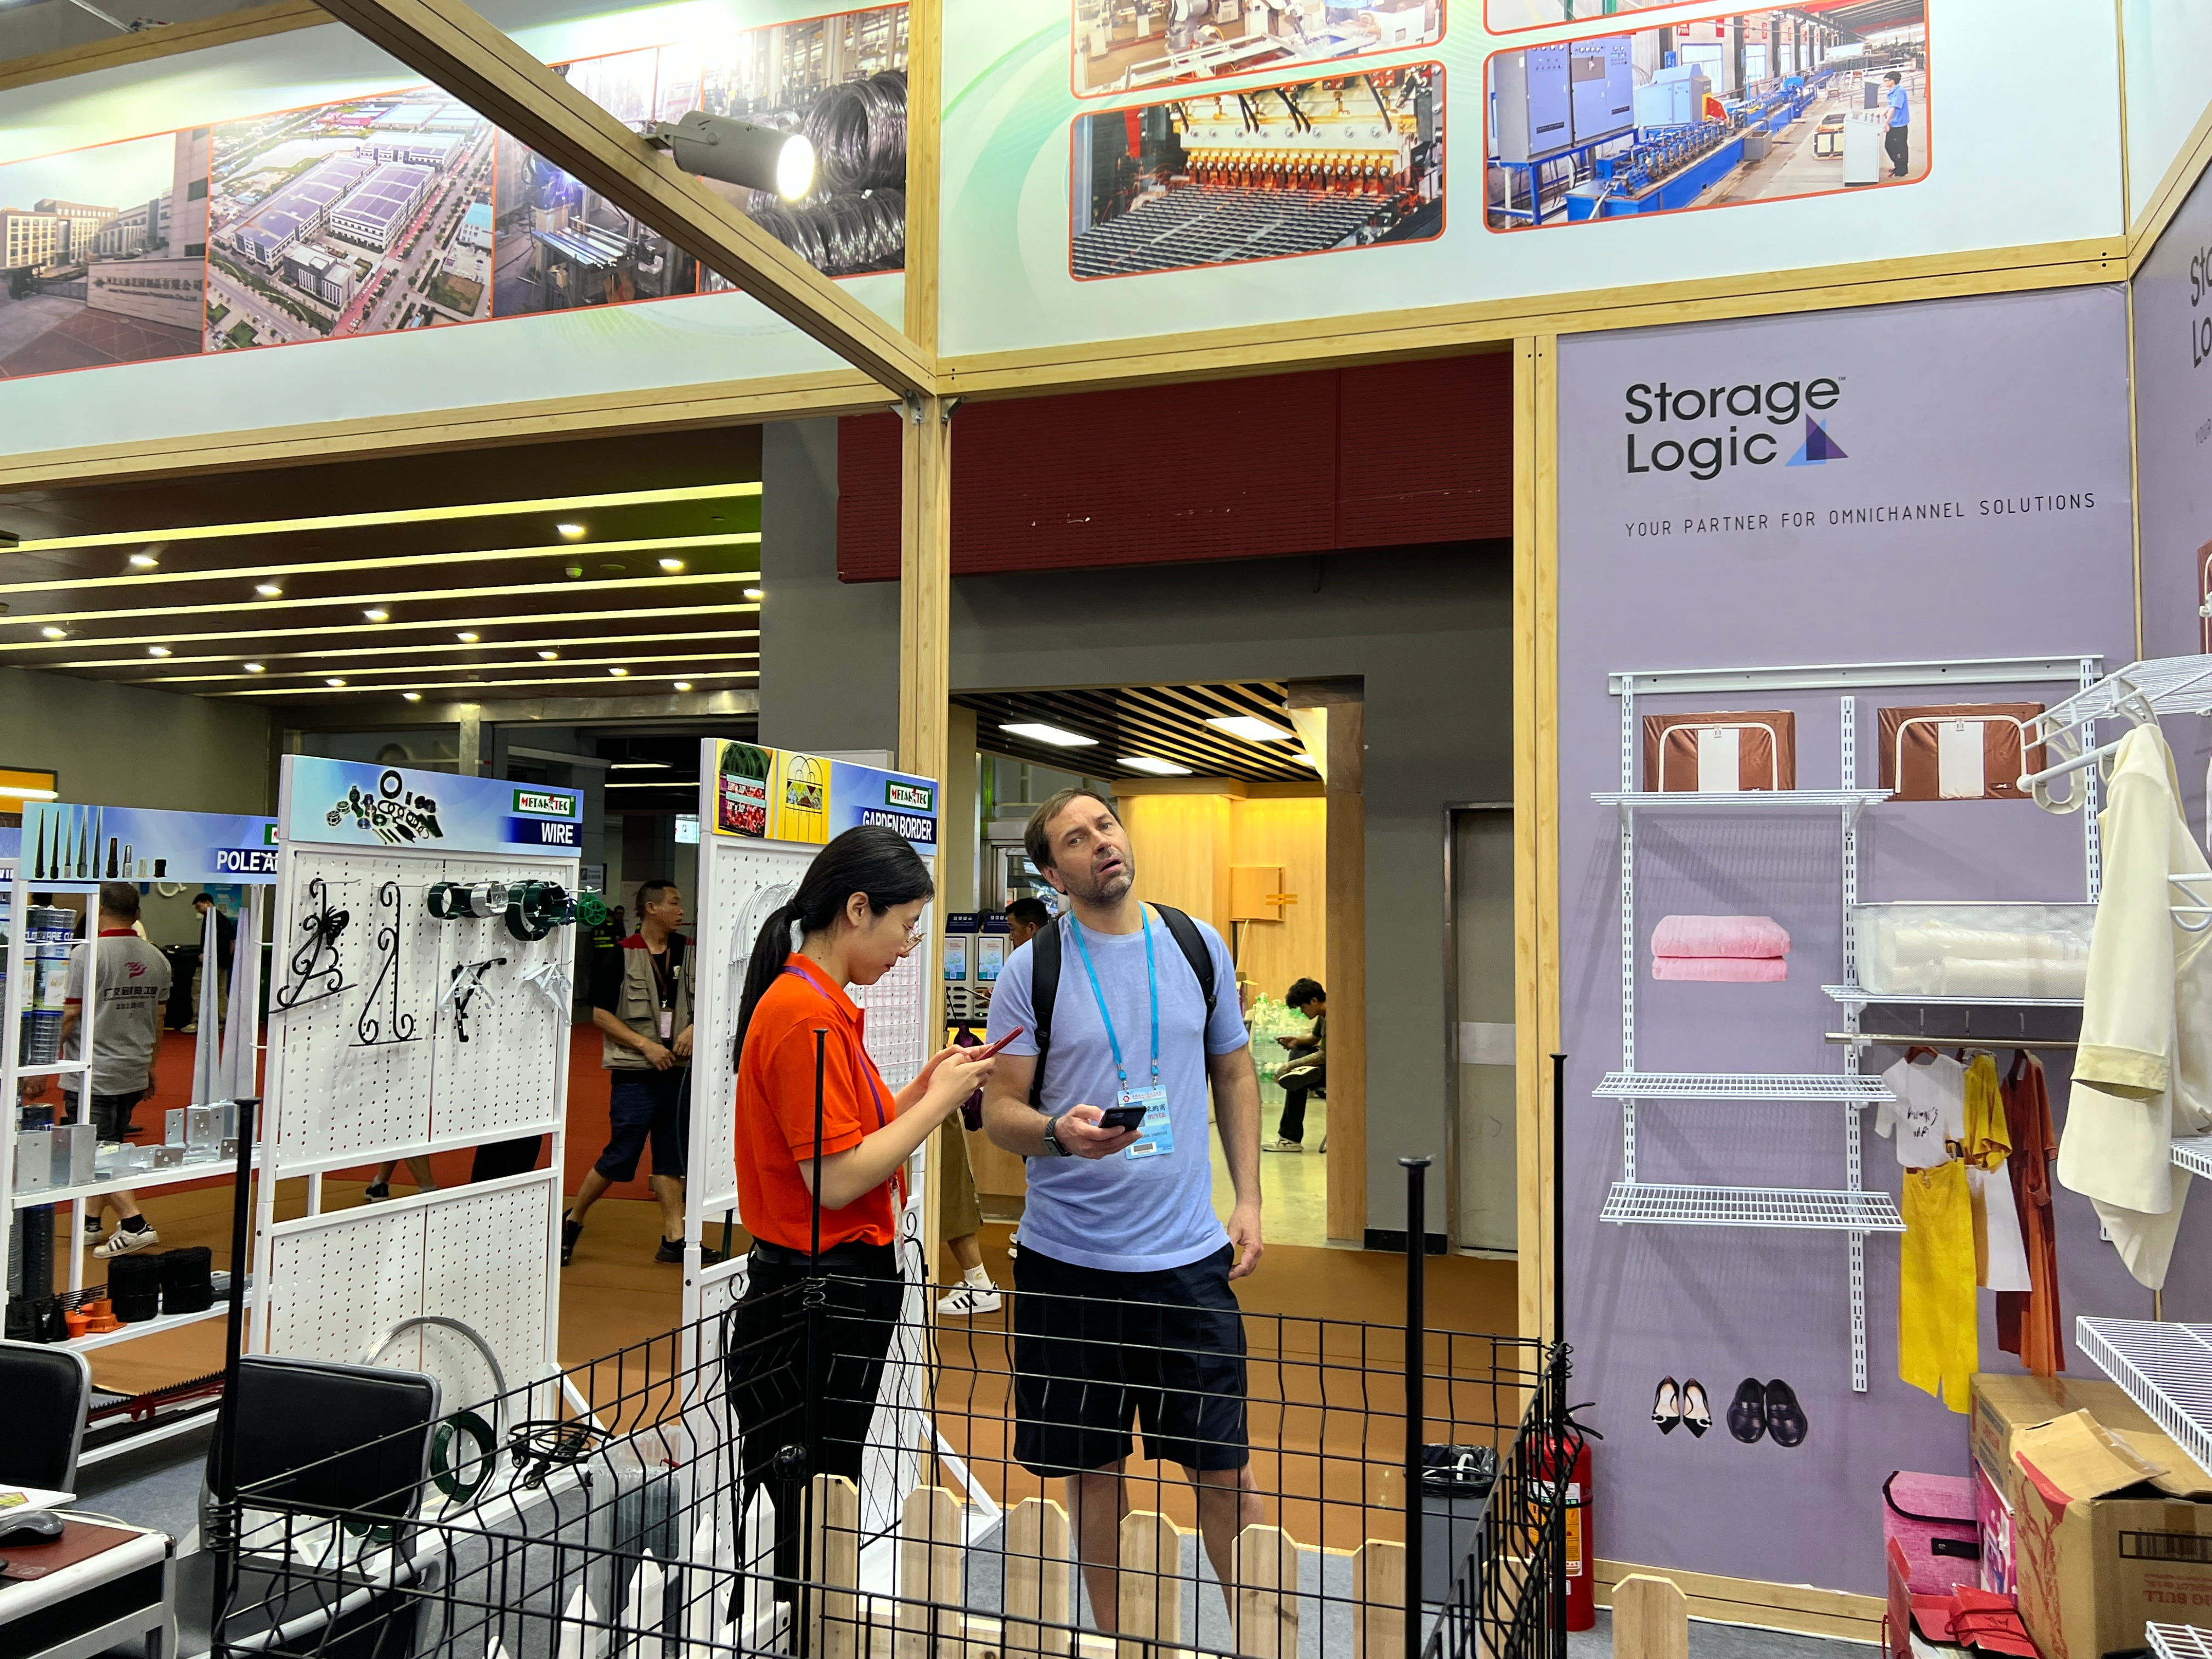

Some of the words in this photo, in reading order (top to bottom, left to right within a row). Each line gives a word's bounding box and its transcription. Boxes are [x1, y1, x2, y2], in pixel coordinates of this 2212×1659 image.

[1625, 378, 1840, 425] Storage
[1627, 426, 1778, 480] Logic
[1626, 521, 1671, 538] YOUR
[1685, 515, 1768, 534] PARTNER
[1782, 511, 1815, 528] FOR
[1829, 502, 1965, 525] OMNICHANNEL
[1980, 493, 2095, 516] SOLUTIONS
[541, 822, 574, 844] WIRE
[862, 810, 899, 832] GARDEN
[900, 816, 932, 840] BORDER
[217, 850, 260, 871] POLE
